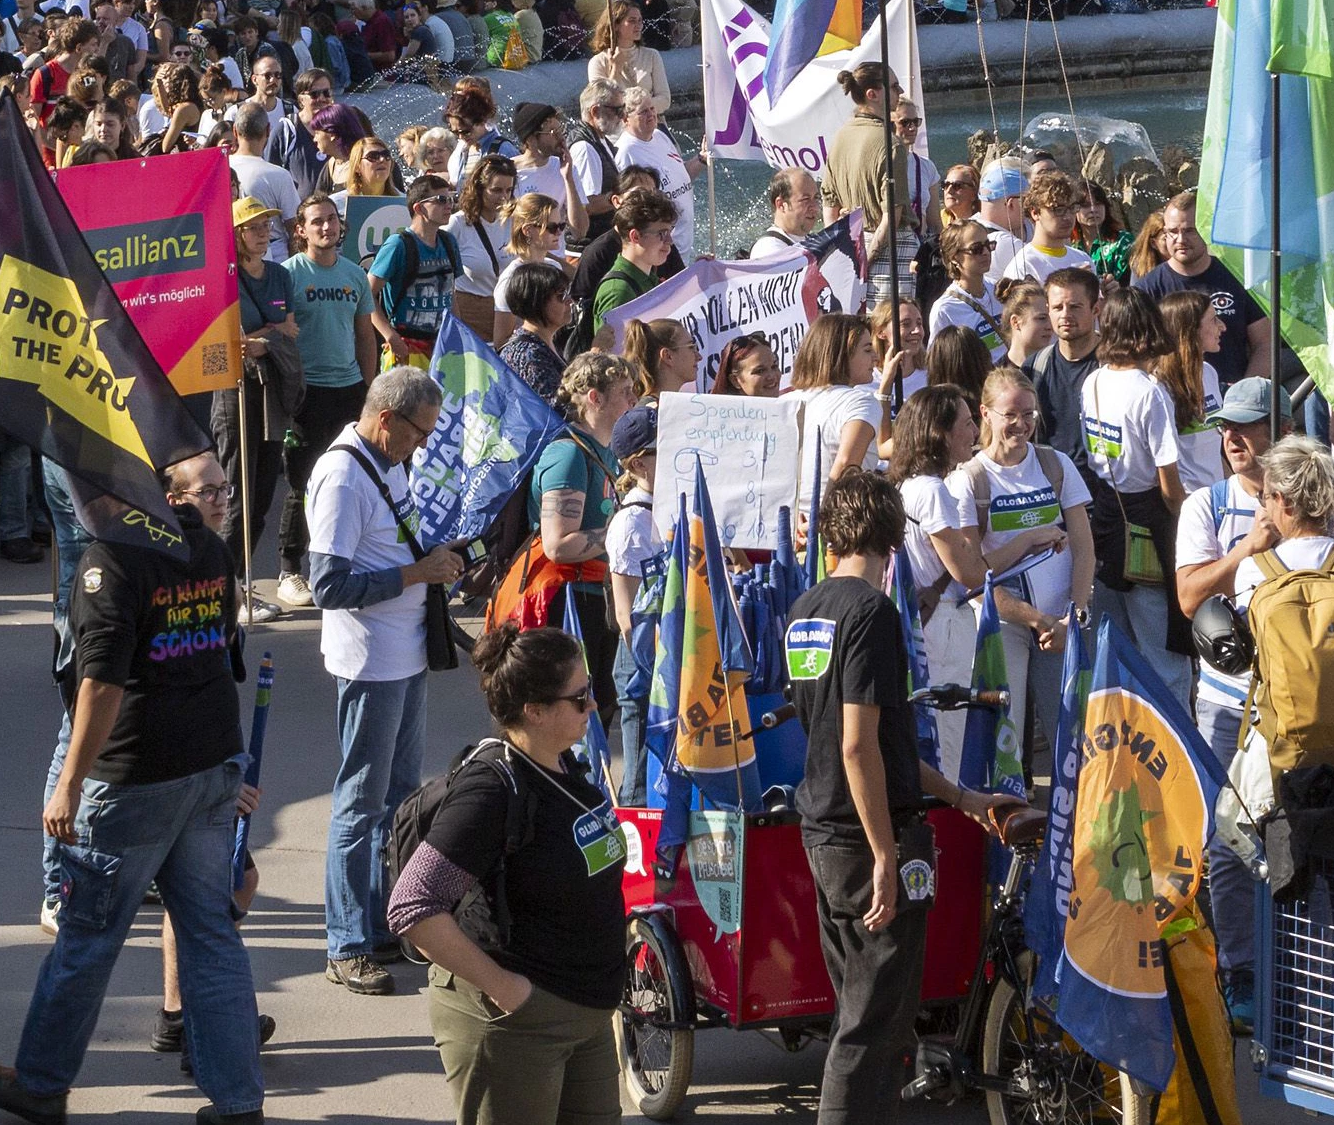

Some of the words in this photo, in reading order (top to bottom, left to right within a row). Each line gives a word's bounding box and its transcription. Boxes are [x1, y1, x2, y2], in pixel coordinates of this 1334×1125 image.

[129, 293, 155, 308] wir's
[159, 285, 205, 304] möglich!
[12, 336, 62, 365] THE
[685, 424, 777, 456] empfehlung
[166, 606, 193, 628] FÜR
[196, 601, 222, 624] DAS
